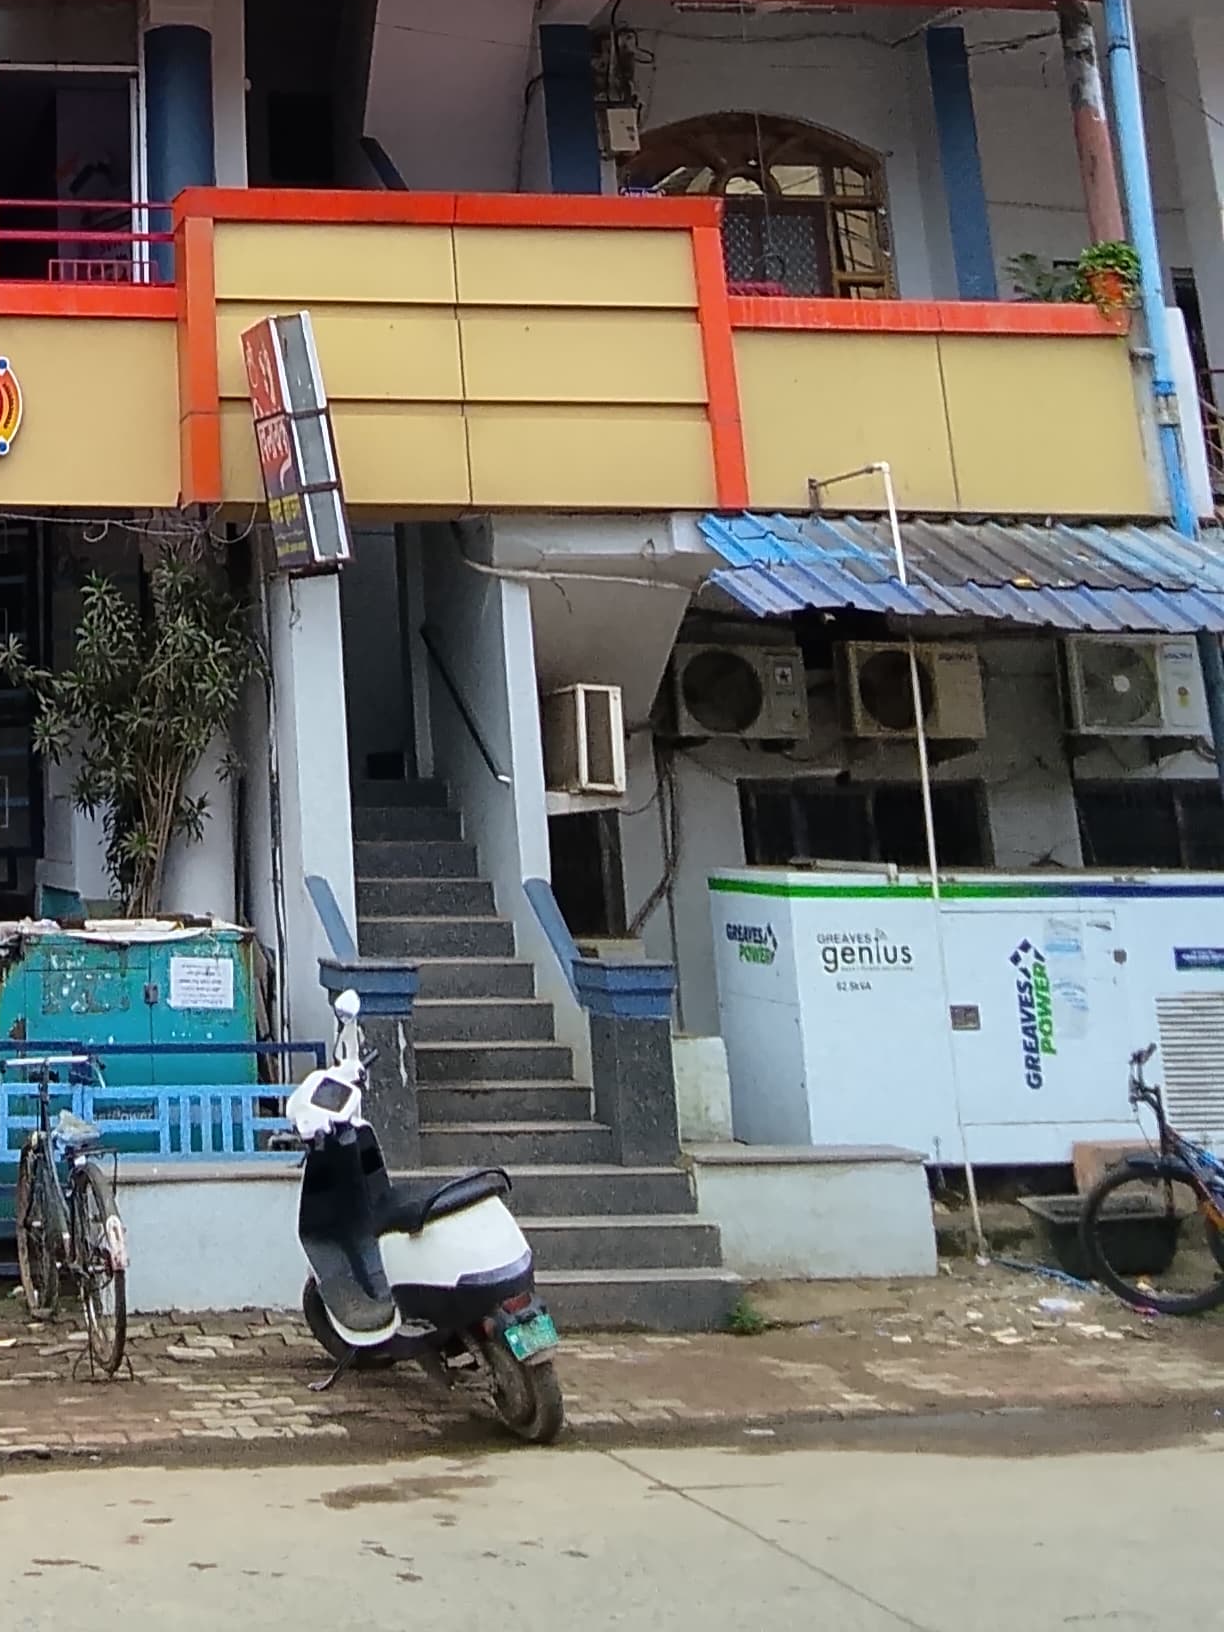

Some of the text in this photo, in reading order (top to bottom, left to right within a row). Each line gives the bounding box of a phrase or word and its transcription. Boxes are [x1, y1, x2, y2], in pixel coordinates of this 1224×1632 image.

[817, 932, 872, 945] GREAVES
[821, 938, 913, 974] genius
[1017, 978, 1043, 1090] GREAVES
[1032, 961, 1057, 1056] POWER
